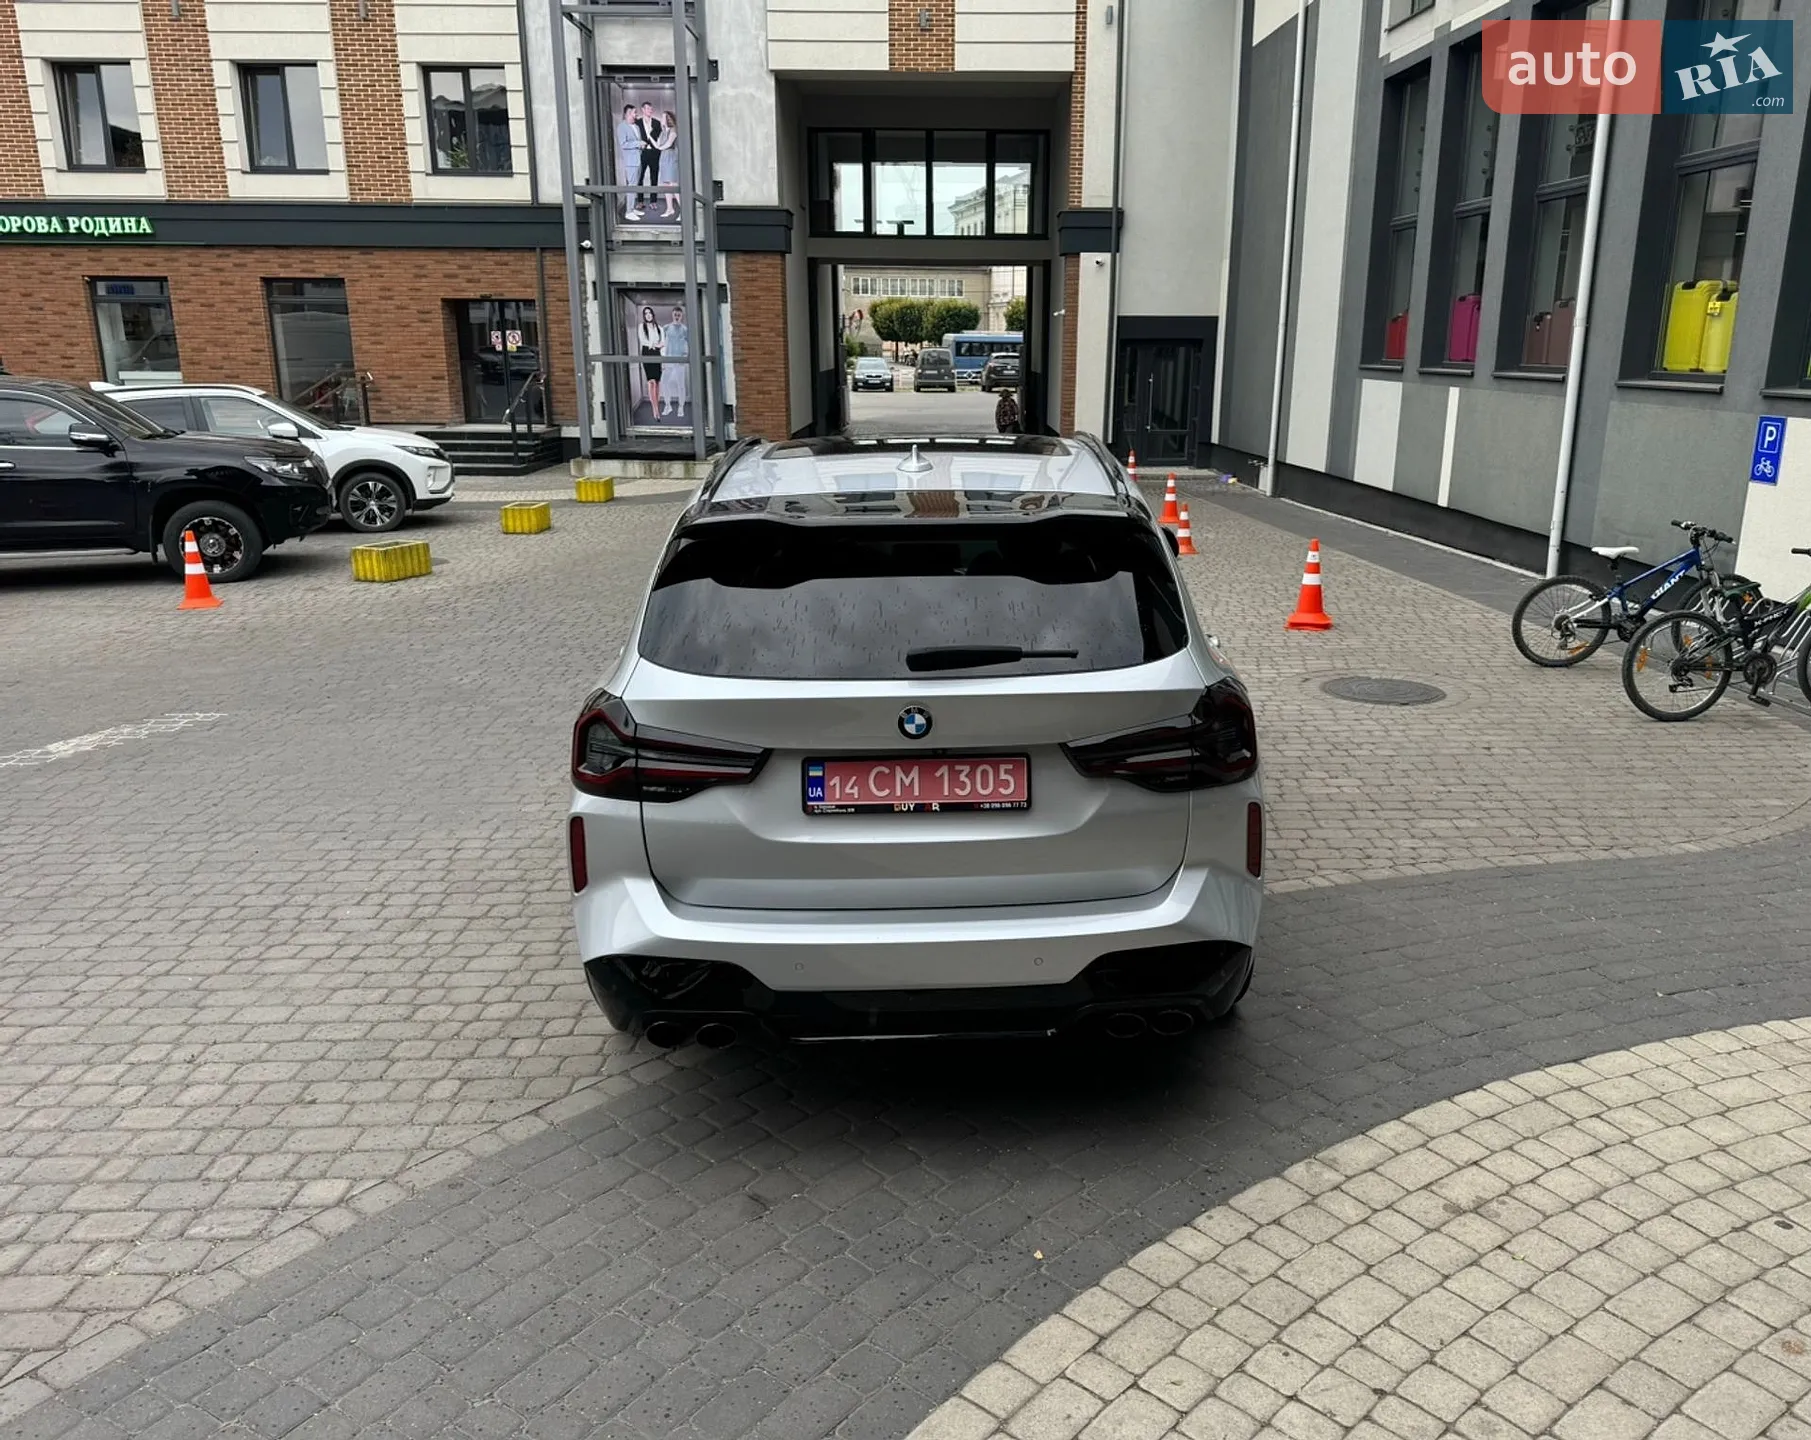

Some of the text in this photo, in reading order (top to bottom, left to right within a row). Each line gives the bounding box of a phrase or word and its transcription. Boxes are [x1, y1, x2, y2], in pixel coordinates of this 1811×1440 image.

[67, 216, 153, 237] РОДИНА
[1764, 425, 1777, 449] P
[1650, 569, 1686, 600] GIANT
[808, 787, 823, 798] UA
[829, 764, 1015, 799] 14 CM 1305
